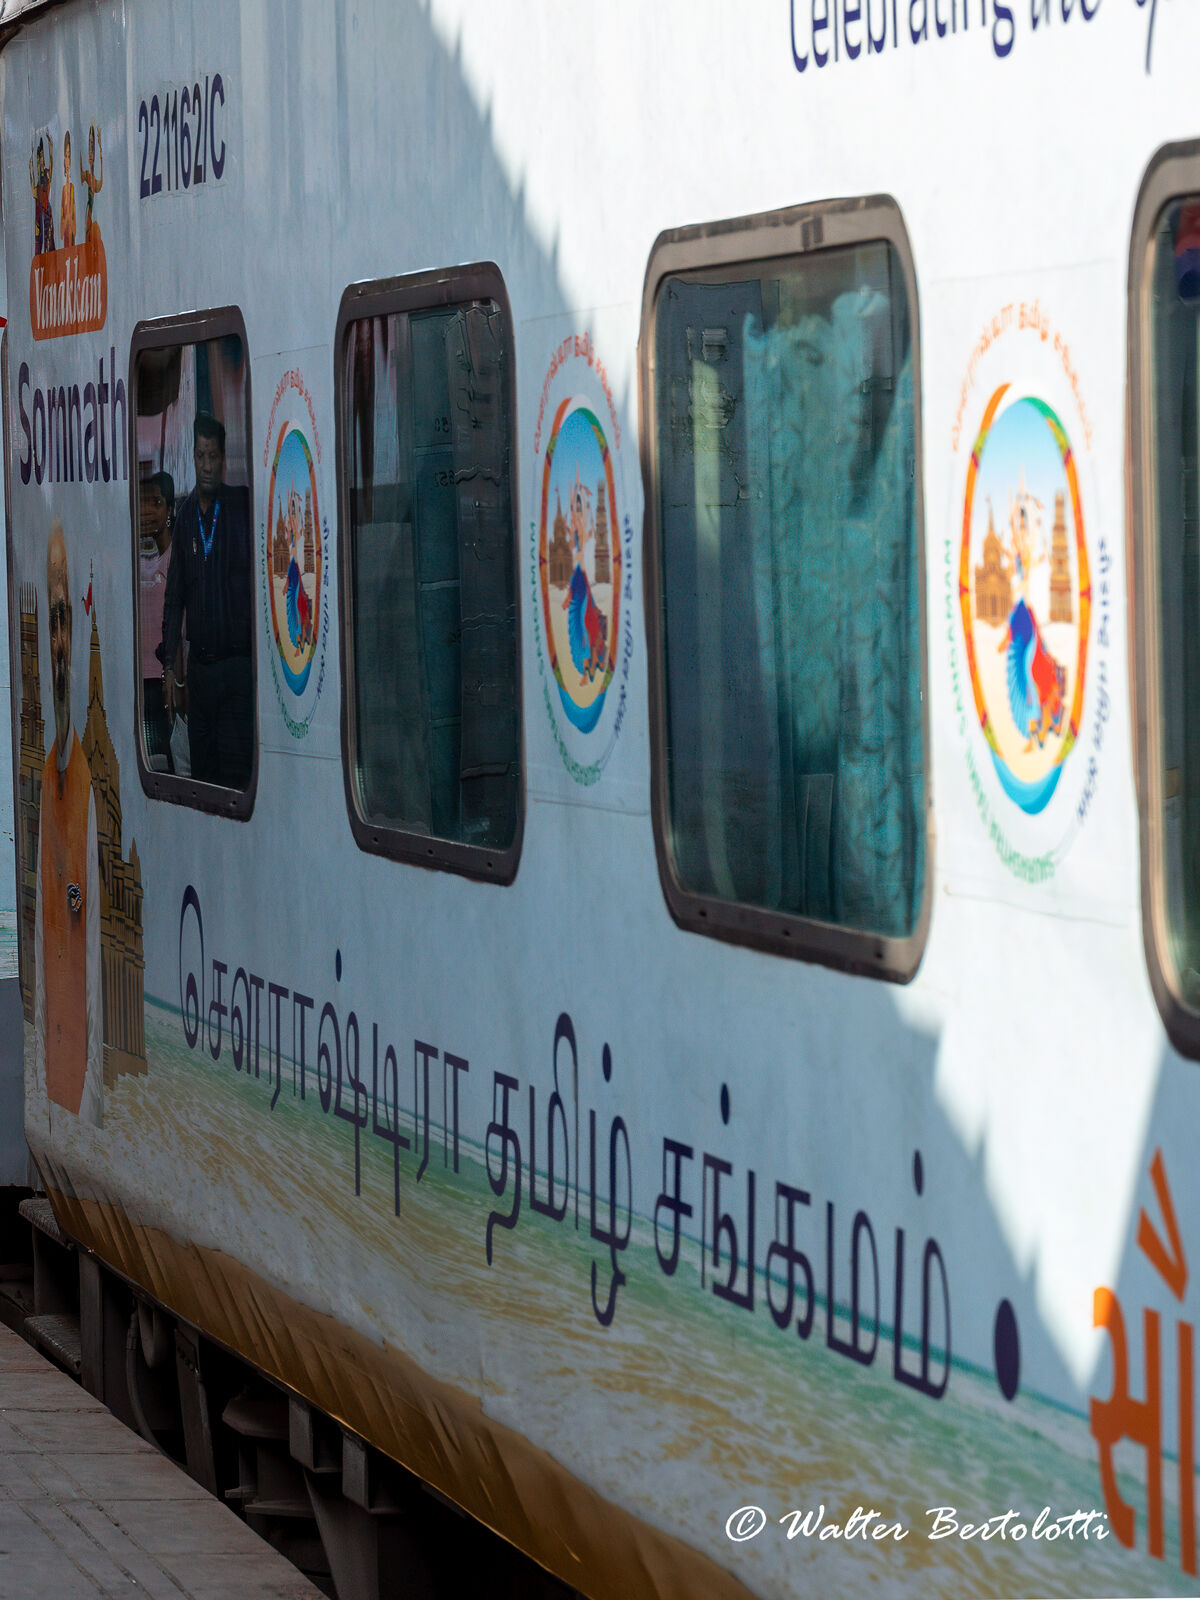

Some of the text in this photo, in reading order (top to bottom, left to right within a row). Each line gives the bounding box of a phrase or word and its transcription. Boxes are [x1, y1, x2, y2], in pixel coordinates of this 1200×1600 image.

[138, 73, 226, 200] 221162/C
[33, 256, 102, 329] Vanakkam
[18, 346, 128, 486] Somnath
[485, 1011, 632, 1327] தமிழ்
[654, 1083, 951, 1399] சங்கமம்
